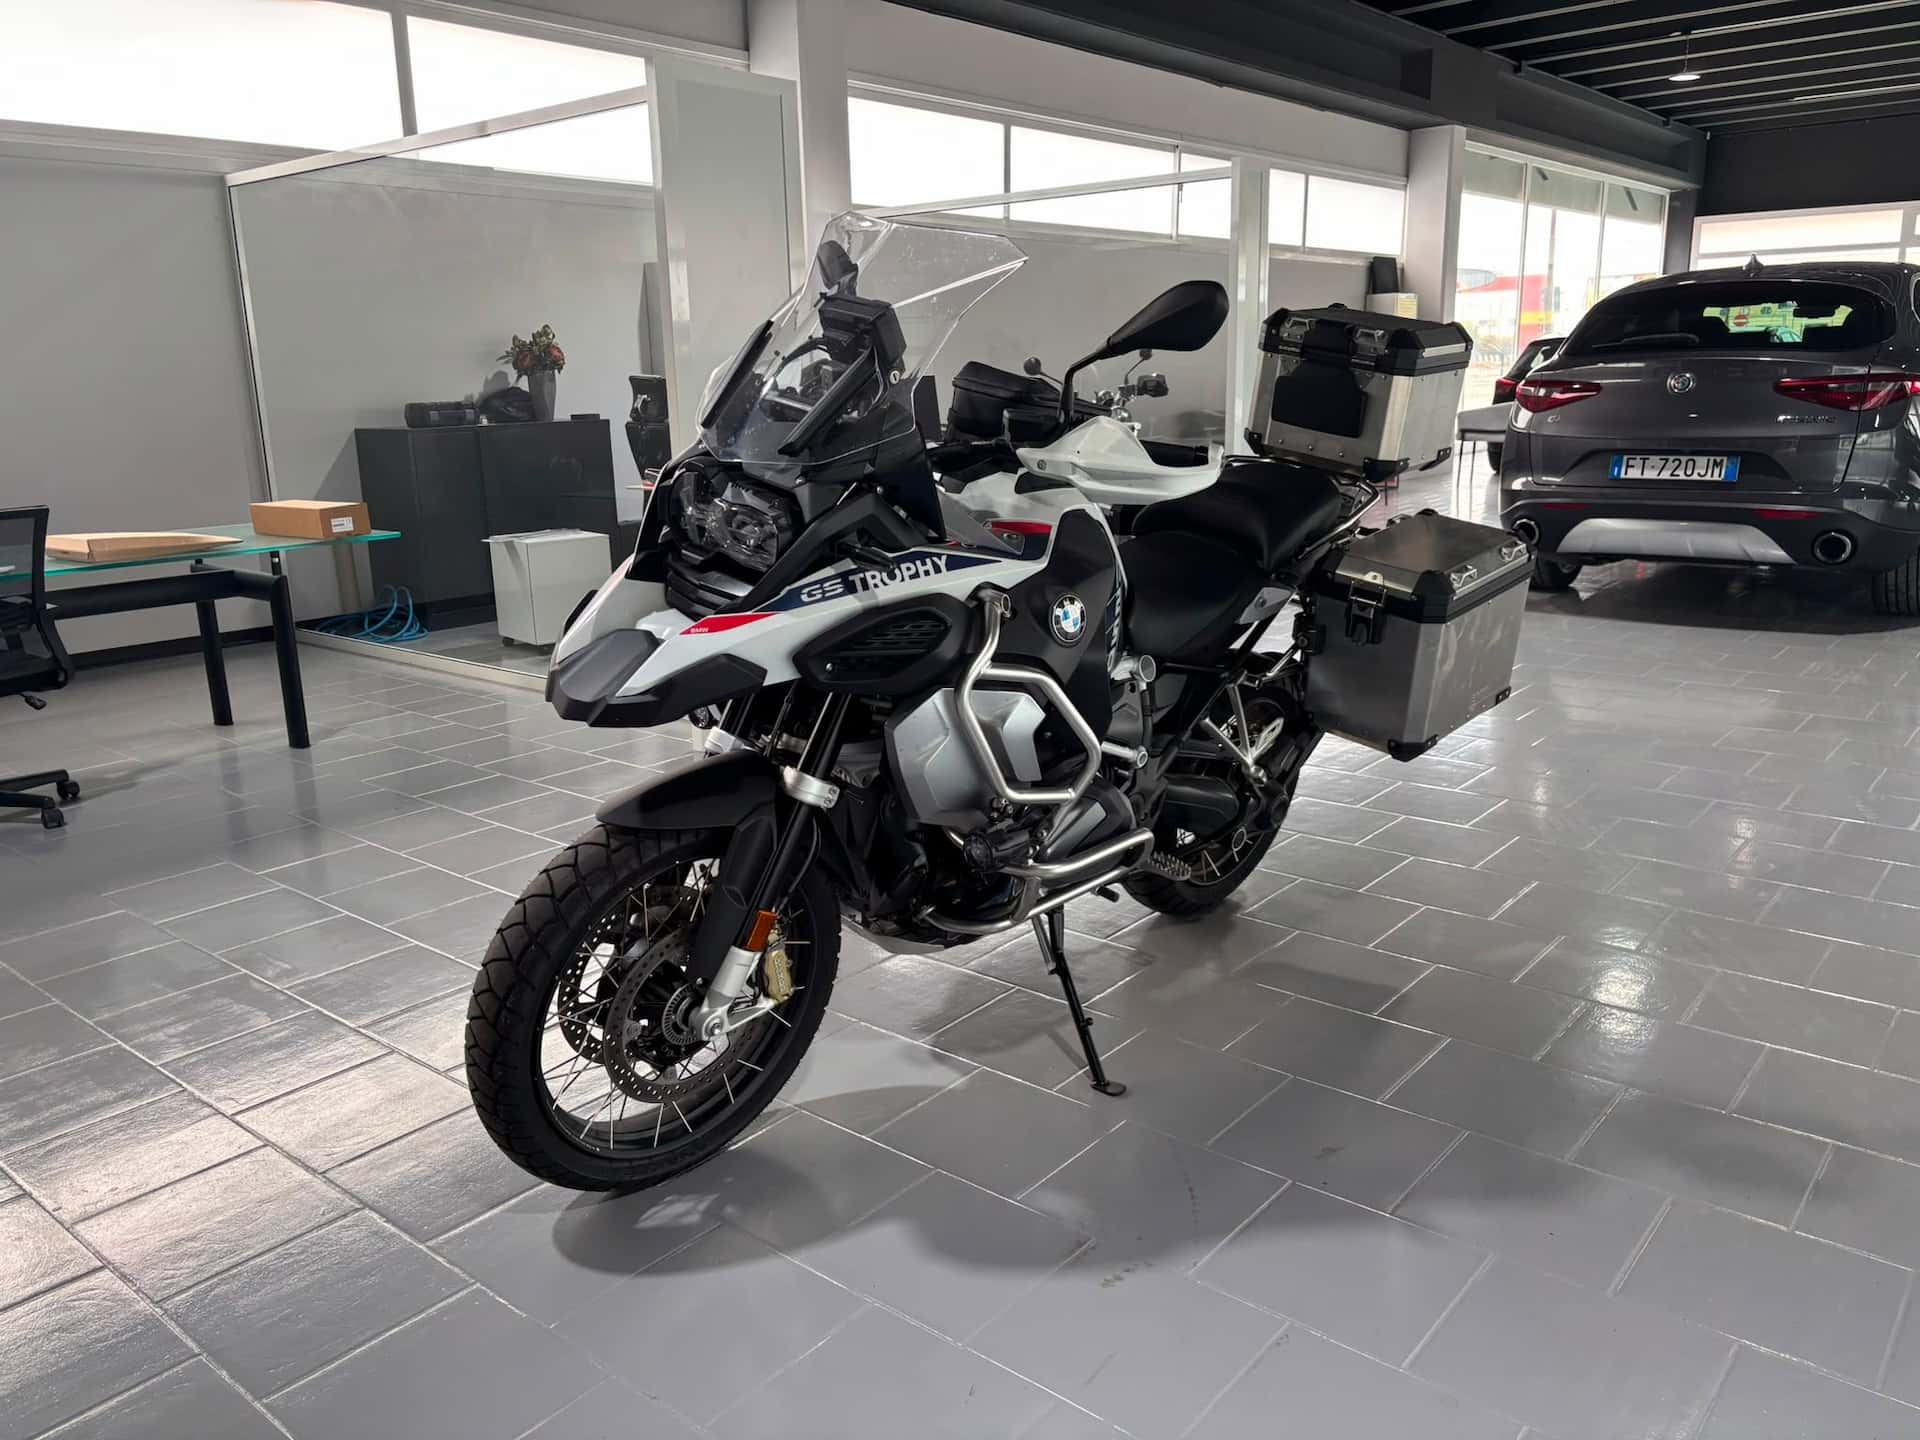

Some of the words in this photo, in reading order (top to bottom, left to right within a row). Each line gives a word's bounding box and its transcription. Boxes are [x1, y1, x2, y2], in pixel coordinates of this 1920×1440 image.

[1624, 457, 1650, 476] FT
[1656, 457, 1724, 478] 720JM
[801, 578, 845, 602] GS
[848, 555, 947, 594] TROPHY
